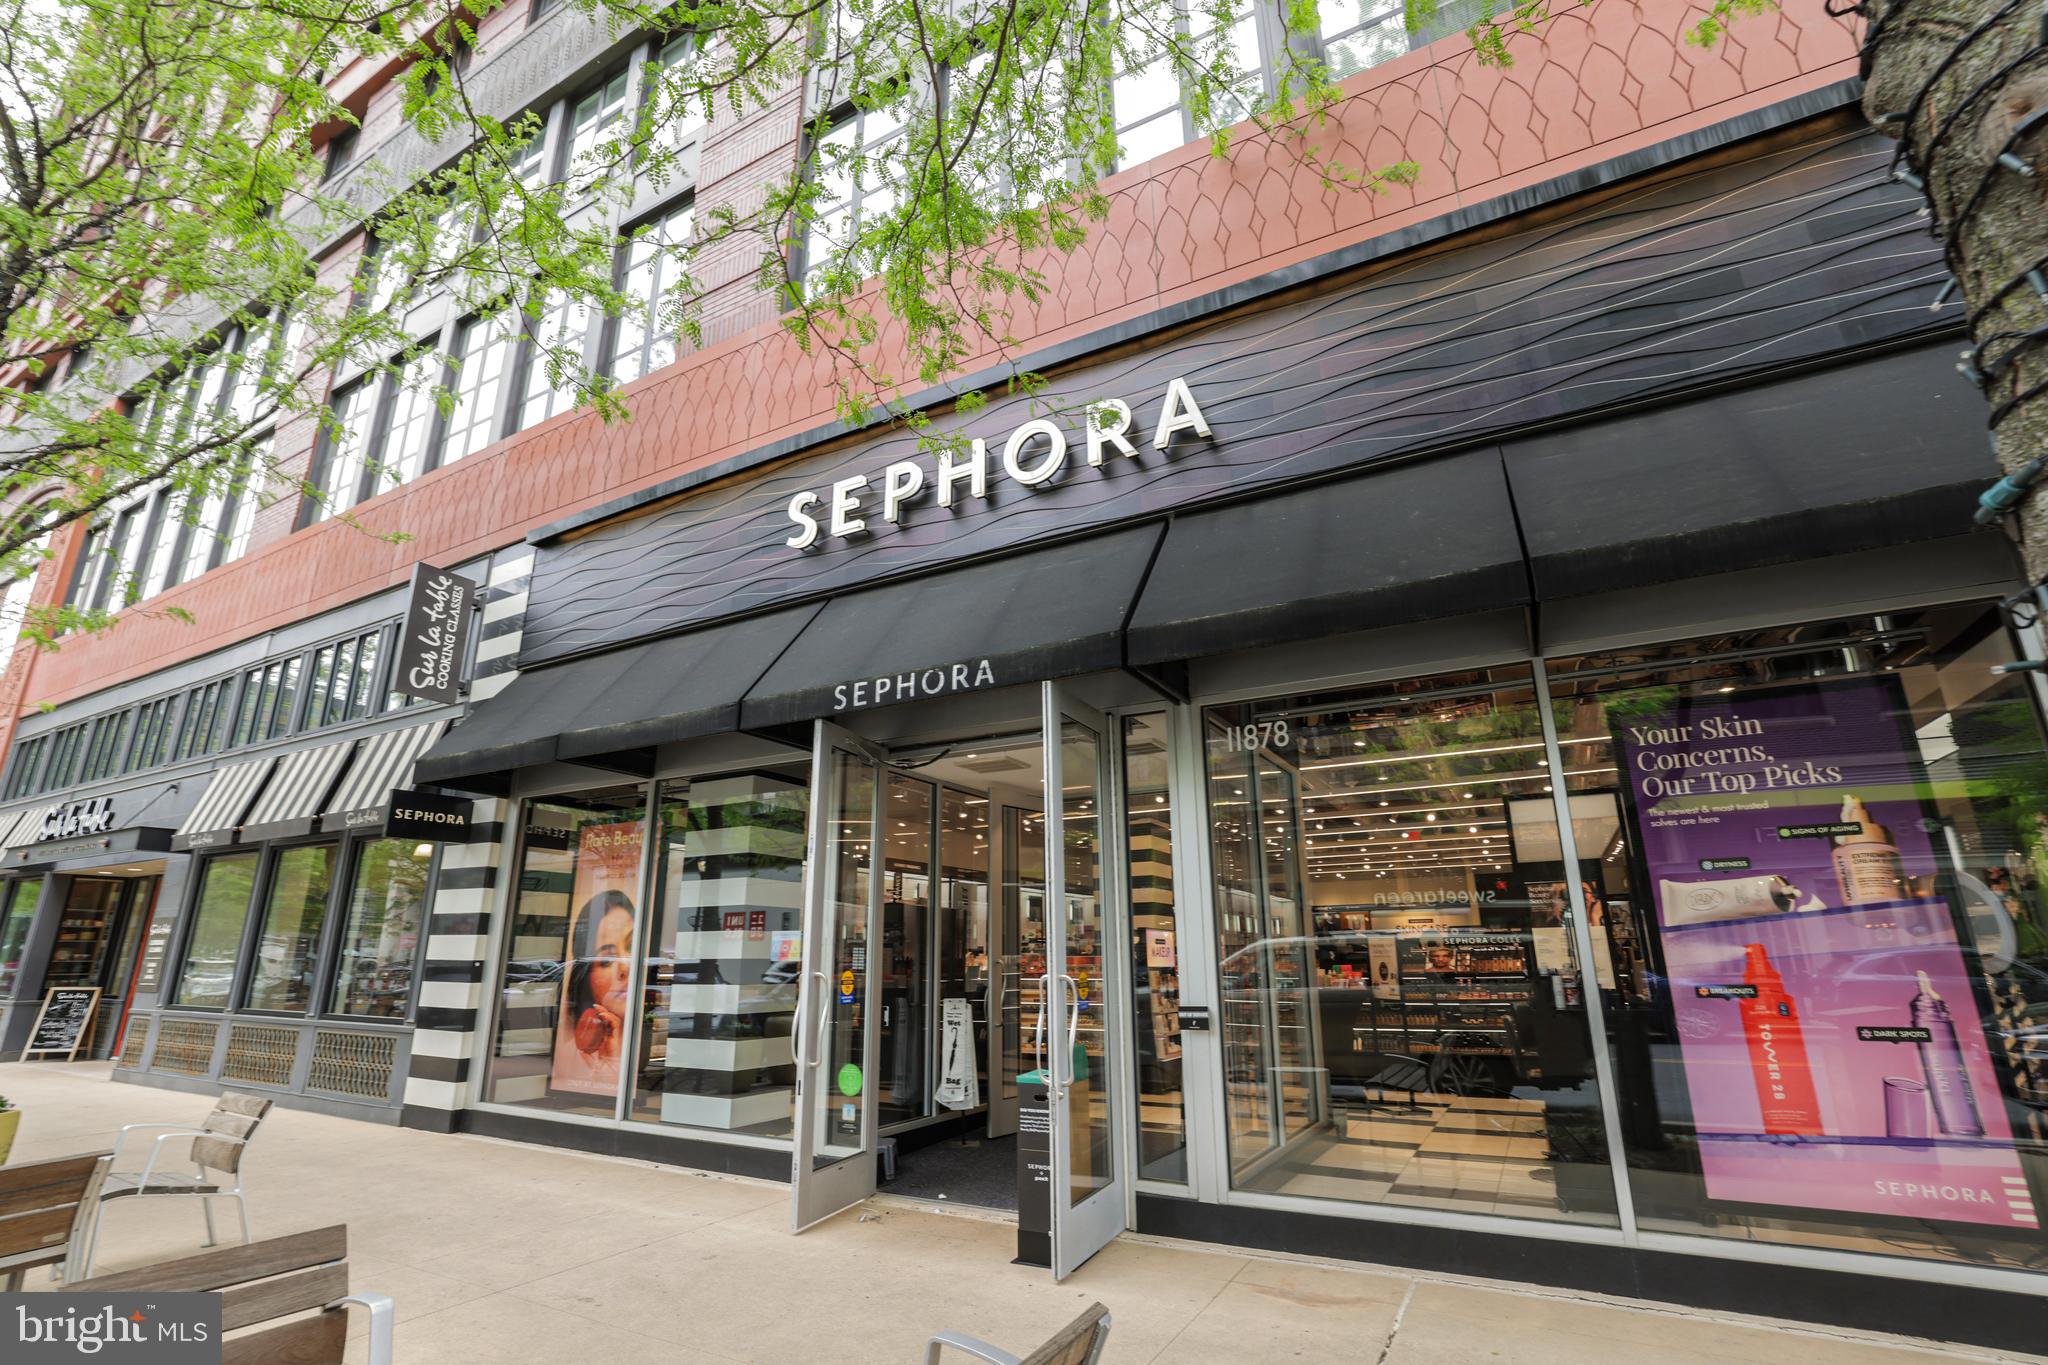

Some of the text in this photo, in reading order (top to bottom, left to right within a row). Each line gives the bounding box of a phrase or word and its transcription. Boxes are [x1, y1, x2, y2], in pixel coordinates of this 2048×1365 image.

[786, 377, 1214, 550] SEPHORA
[409, 575, 453, 689] Sur la table
[436, 585, 465, 690] COOKING CLASSES
[833, 659, 996, 710] SEPHORA
[1227, 720, 1290, 753] 11878
[1630, 715, 1764, 746] Your Skin
[1636, 745, 1775, 772] Concerns,
[1641, 761, 1843, 798] Our Top Picks
[394, 808, 465, 826] SEPHORA
[1648, 800, 1769, 817] The newest & most trusted
[1650, 815, 1678, 827] solves
[1698, 814, 1720, 824] here
[1790, 824, 1859, 835] SIGNS OF AGING
[585, 831, 644, 848] Rare Beau
[1713, 860, 1749, 869] DRYNESS
[1443, 934, 1521, 946] SEPHORA COLLE
[947, 1019, 961, 1027] Wet
[1872, 1030, 1929, 1039] DARK SPOTS
[1759, 1023, 1781, 1080] TOWER
[945, 1077, 961, 1086] Bag
[1027, 1163, 1051, 1171] SEPHO
[1874, 1179, 1996, 1205] SEPHORA
